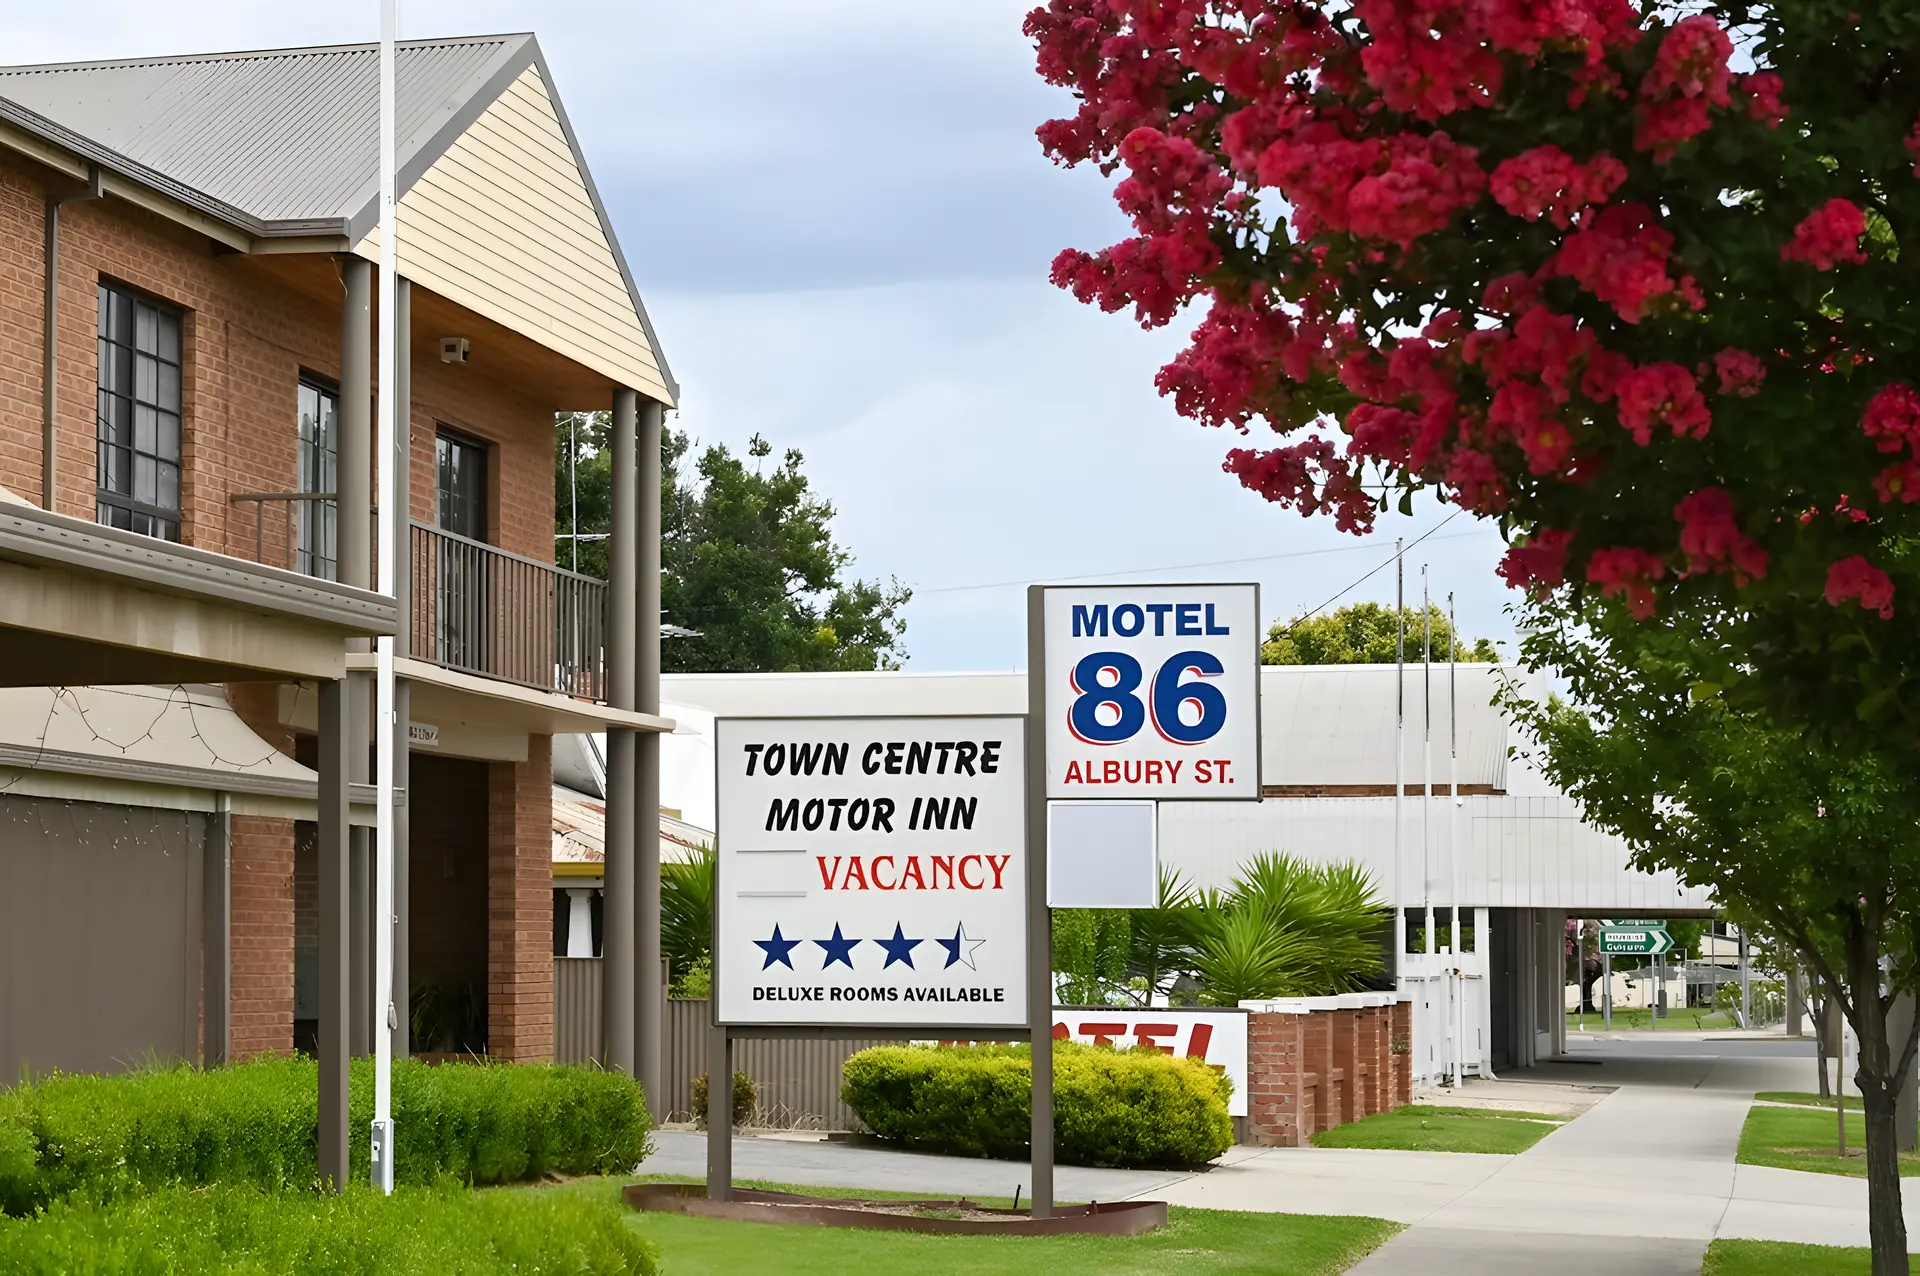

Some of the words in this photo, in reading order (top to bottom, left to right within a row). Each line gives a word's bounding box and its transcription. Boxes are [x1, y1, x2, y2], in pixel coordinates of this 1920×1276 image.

[1072, 603, 1230, 638] MOTEL
[1066, 650, 1227, 747] 86
[743, 742, 850, 778] TOWN
[861, 740, 1002, 778] CENTRE
[1063, 759, 1184, 785] ALBURY
[1194, 759, 1235, 784] ST.
[765, 796, 895, 834] MOTOR
[908, 796, 978, 831] INN
[815, 854, 1012, 891] VACANCY
[752, 986, 824, 1002] DELUXE
[830, 986, 899, 1002] ROOMS
[903, 986, 1005, 1003] AVAILABLE
